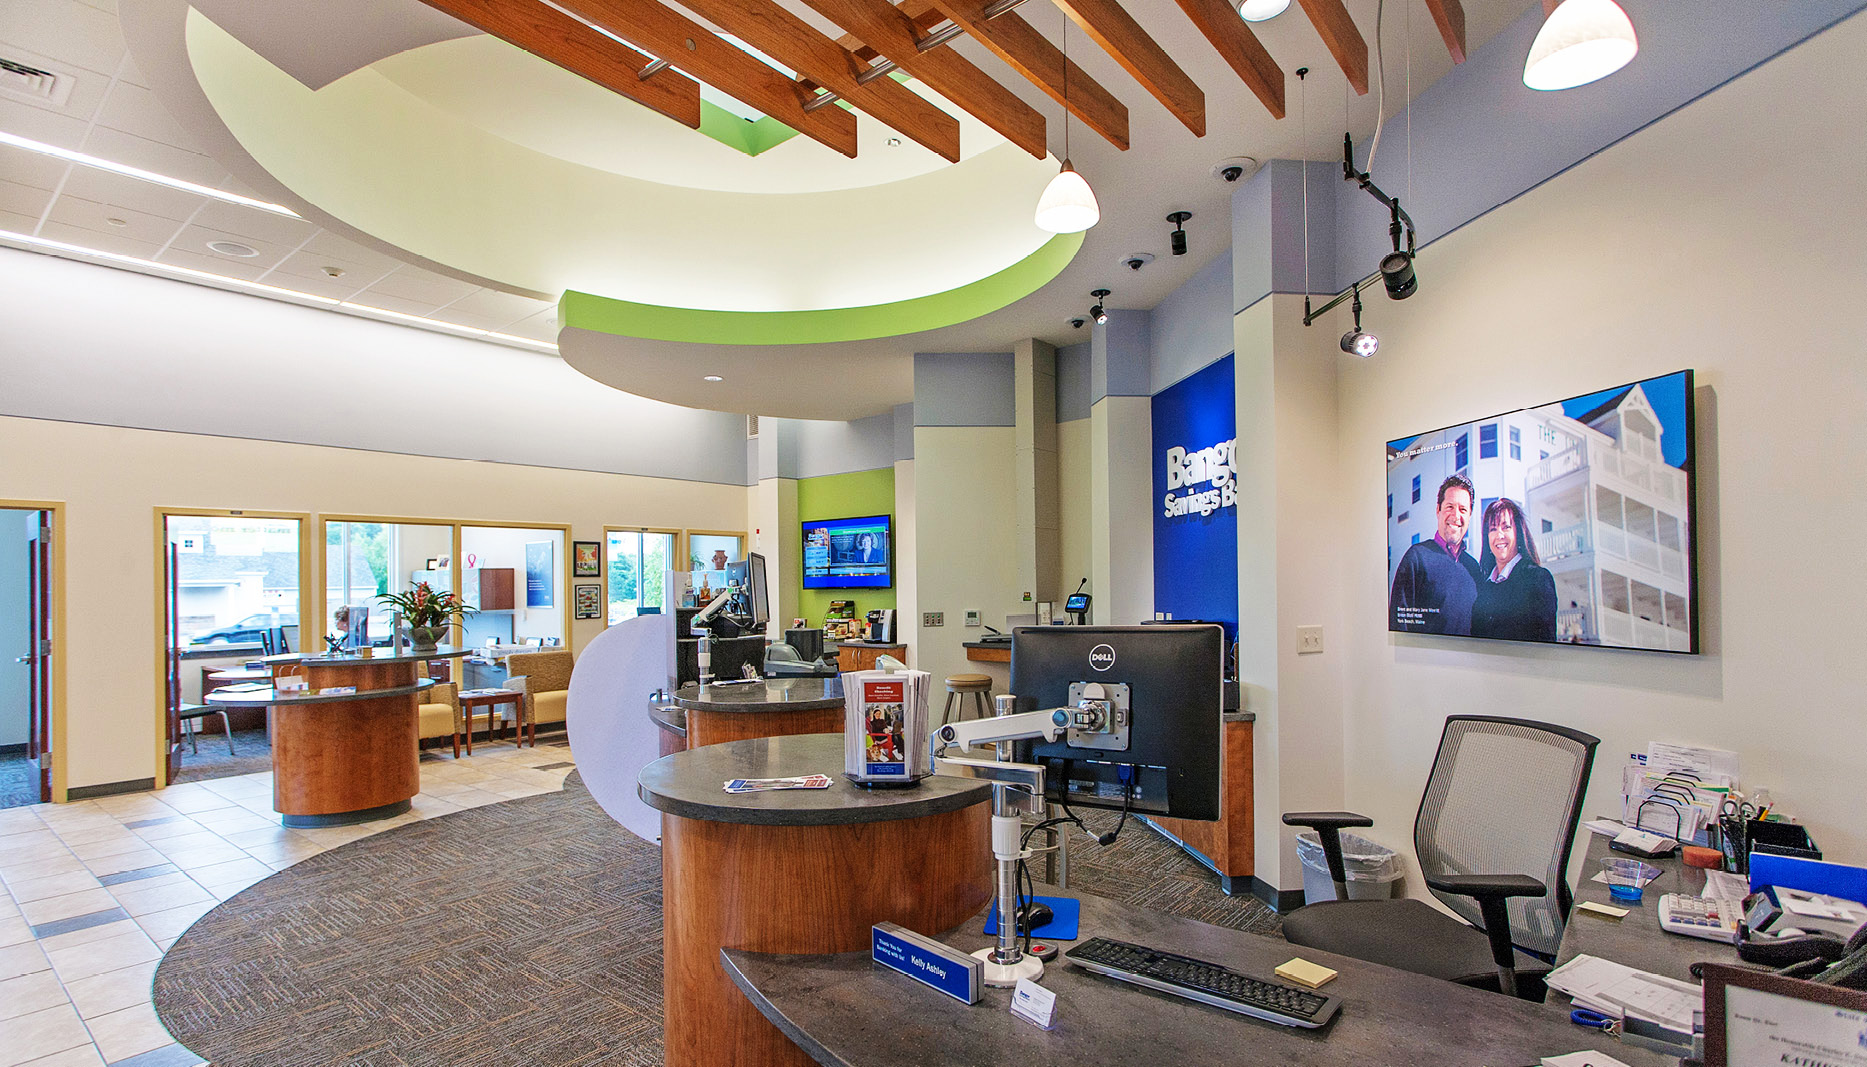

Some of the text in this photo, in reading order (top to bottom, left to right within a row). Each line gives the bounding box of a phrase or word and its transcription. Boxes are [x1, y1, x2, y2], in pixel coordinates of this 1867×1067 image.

[1410, 444, 1435, 456] matter
[1435, 441, 1459, 450] more.
[1164, 479, 1238, 518] Savings B
[1092, 653, 1112, 661] DELL
[879, 938, 890, 948] Thank
[876, 944, 891, 956] Banking
[891, 951, 899, 959] with
[911, 955, 947, 980] Kelly Ashley
